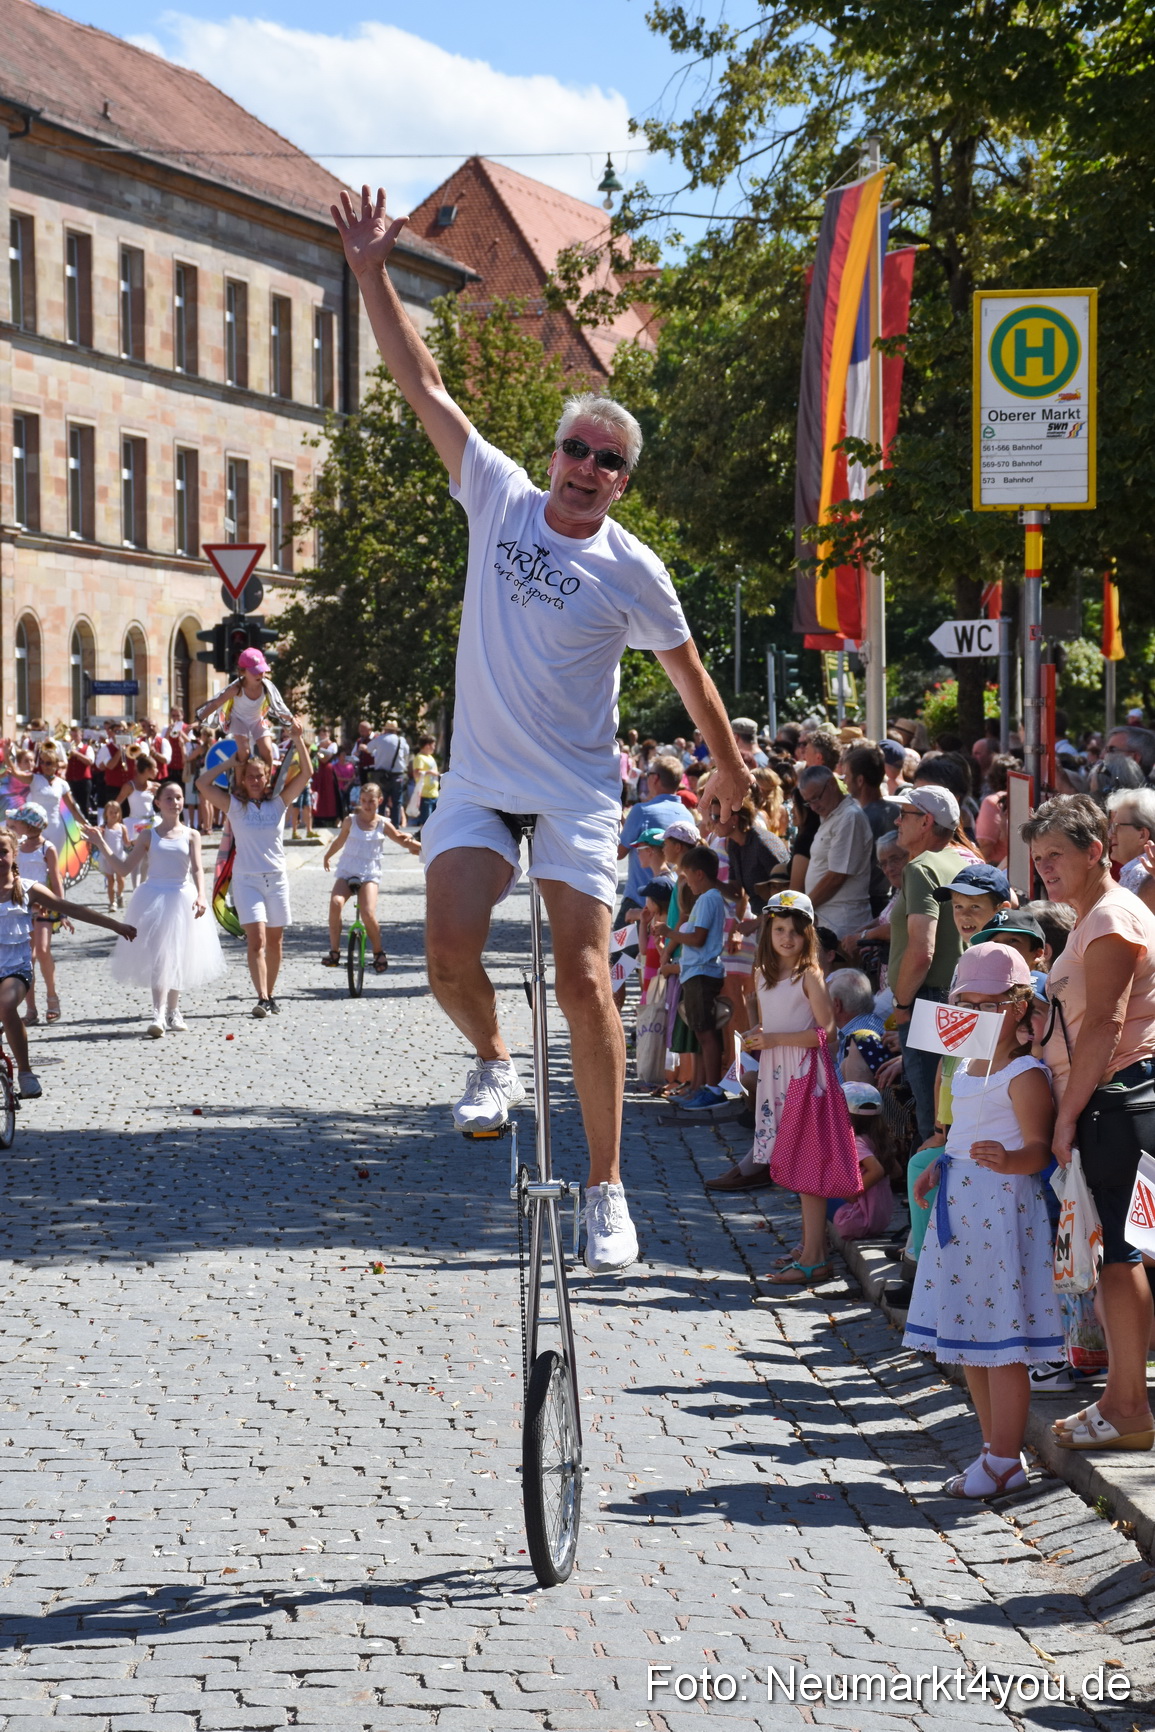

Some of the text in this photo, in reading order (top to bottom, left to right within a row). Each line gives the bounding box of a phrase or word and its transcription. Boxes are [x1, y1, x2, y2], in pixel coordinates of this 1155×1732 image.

[1014, 328, 1055, 377] H
[987, 408, 1081, 422] Oberer Markt
[982, 444, 1010, 452] 561-566
[494, 562, 565, 610] art of sports
[953, 625, 993, 653] WC
